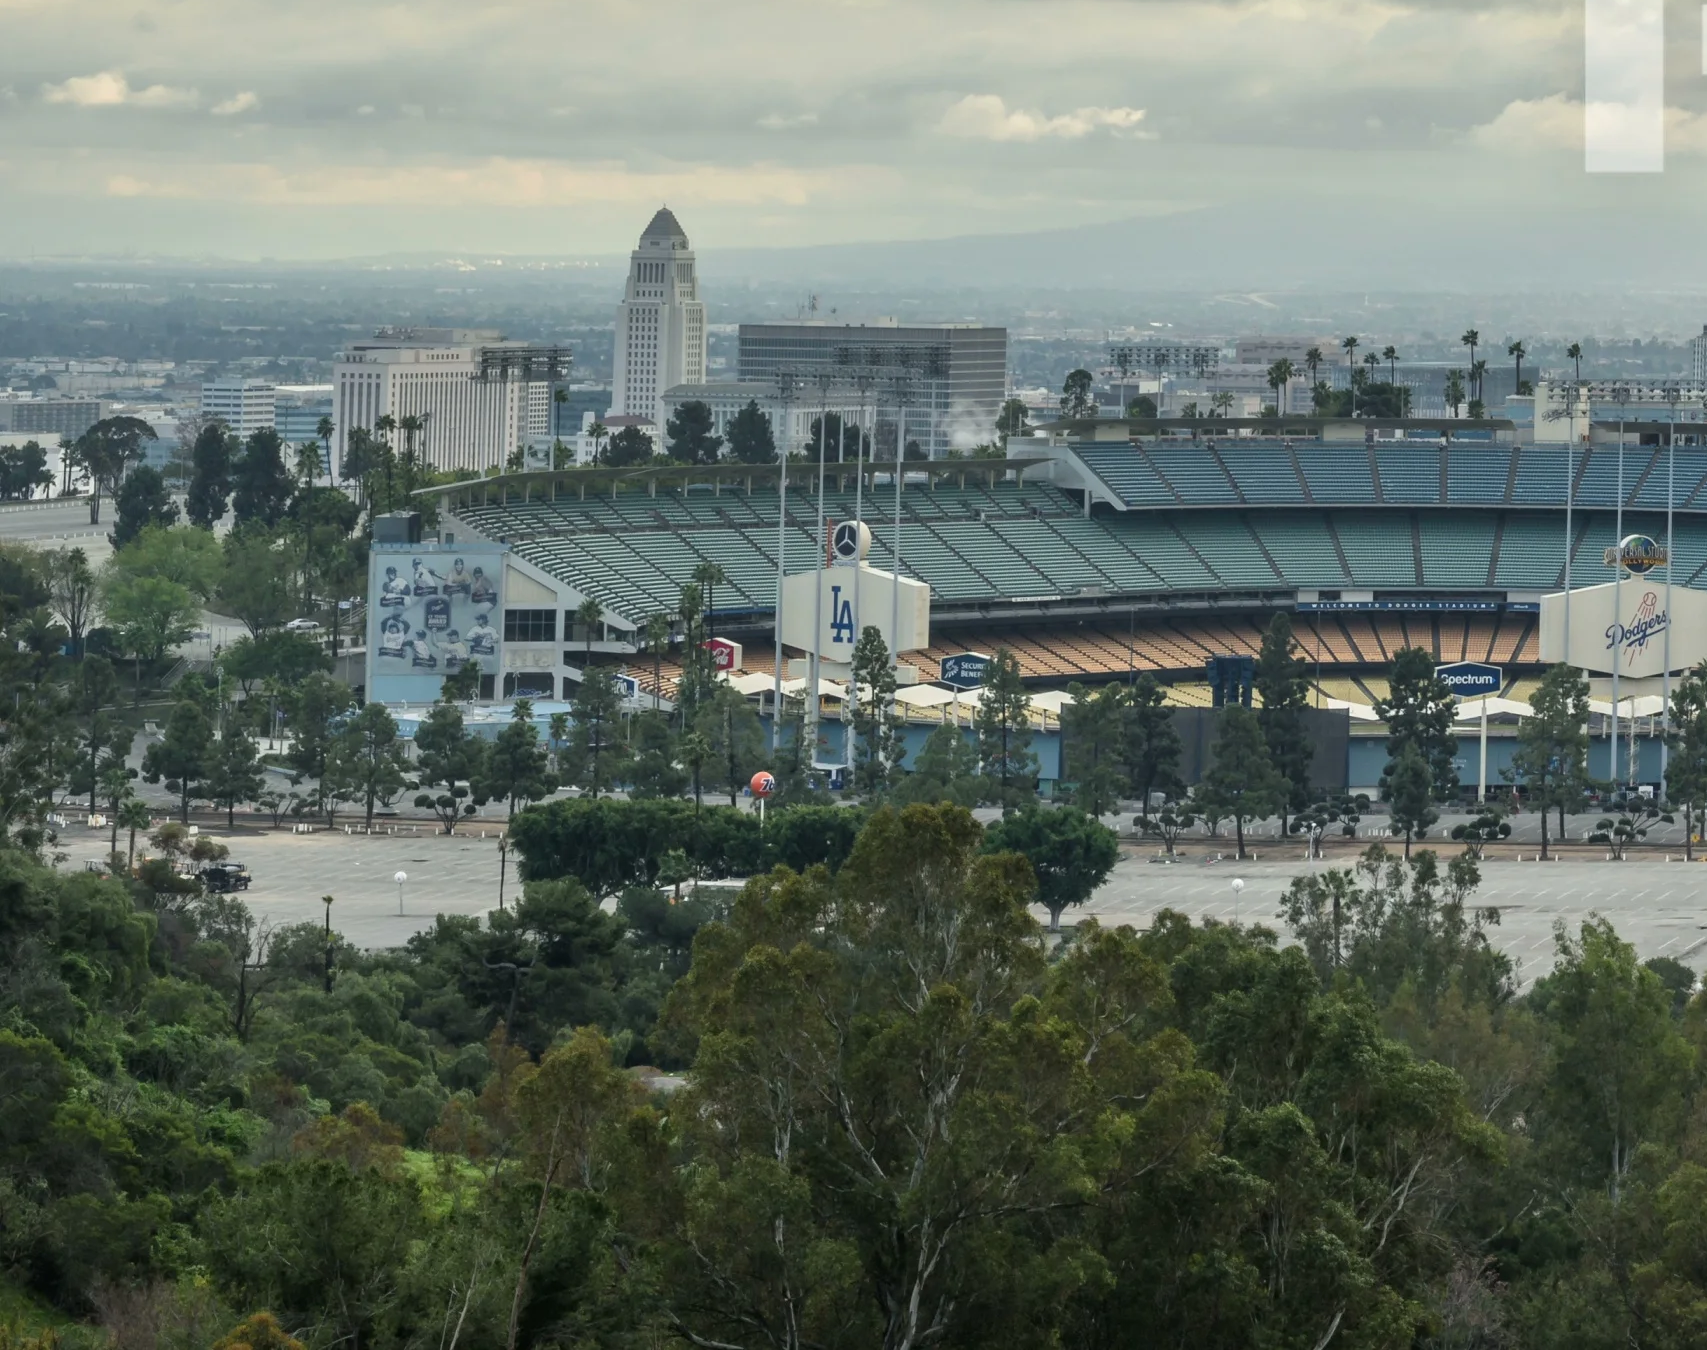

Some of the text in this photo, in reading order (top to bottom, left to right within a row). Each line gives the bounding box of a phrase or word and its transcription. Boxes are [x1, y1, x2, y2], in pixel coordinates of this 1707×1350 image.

[1607, 545, 1646, 561] UNVERSAL
[830, 585, 854, 644] LA
[1605, 610, 1672, 649] Dodgers
[961, 662, 985, 670] SECURI
[1441, 673, 1493, 686] Spectrum
[760, 777, 776, 791] 76
